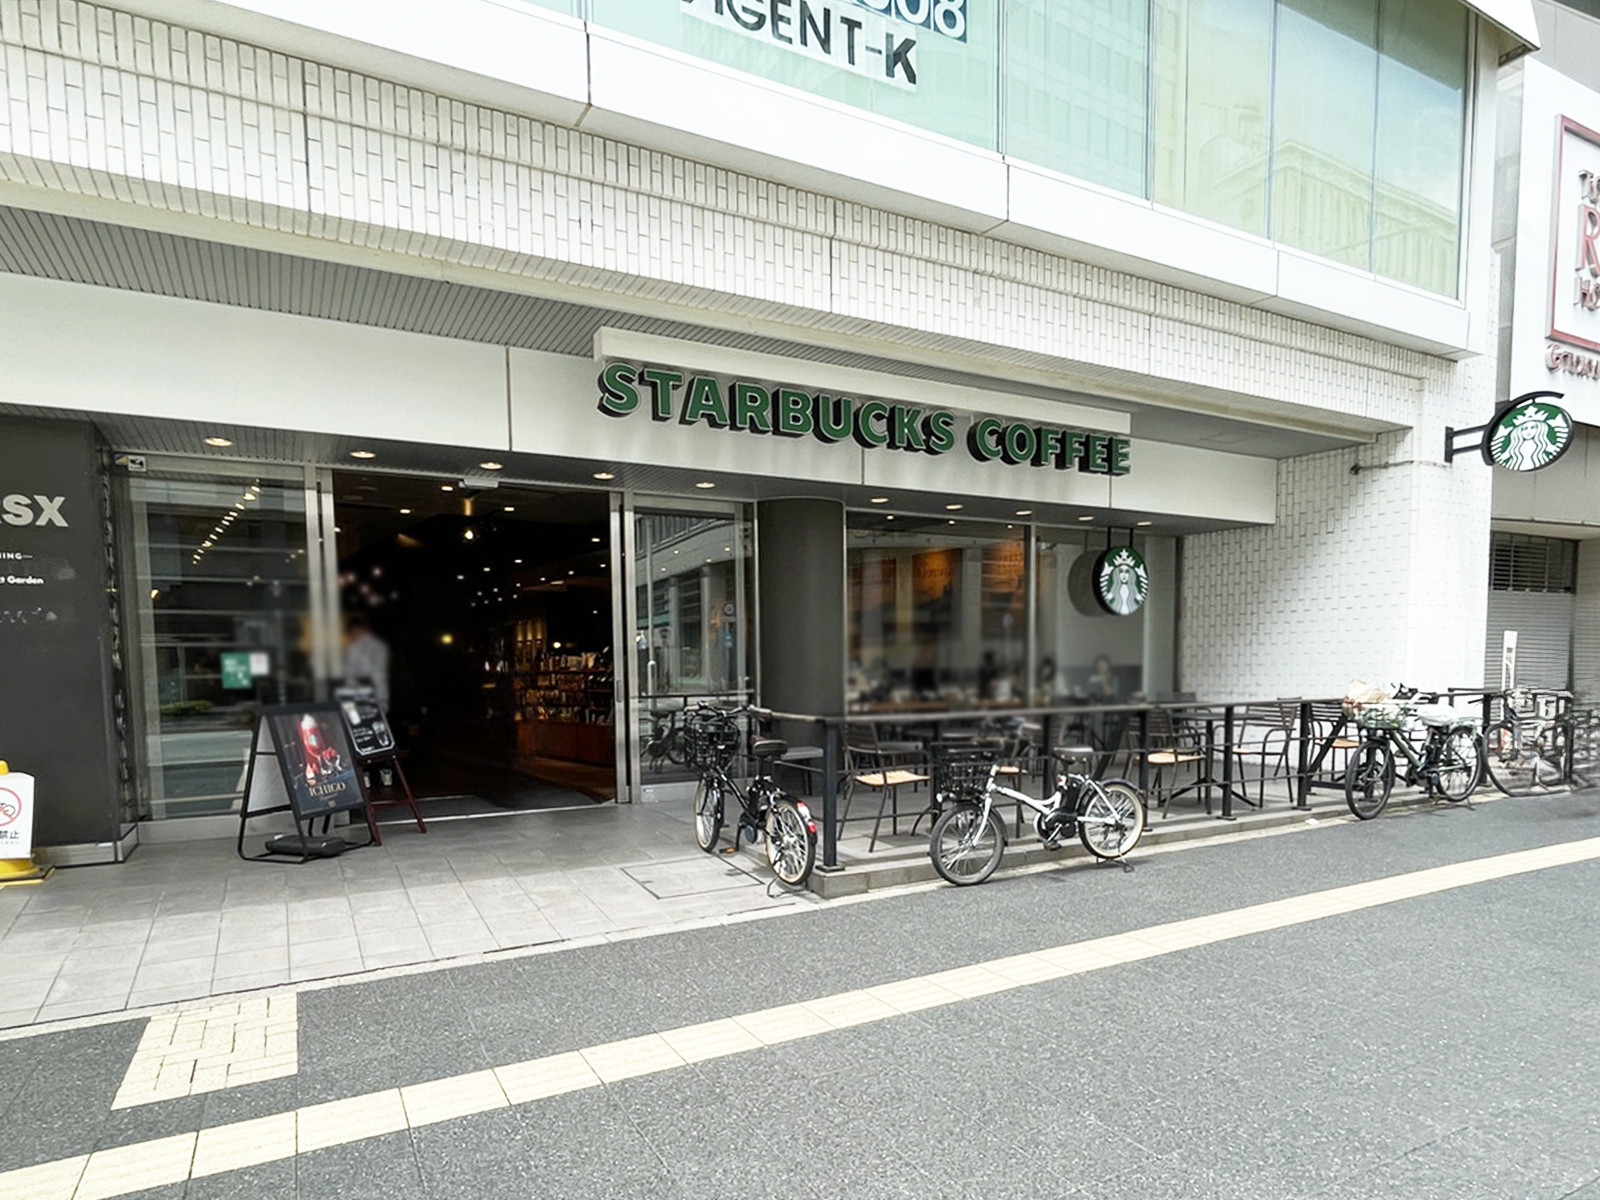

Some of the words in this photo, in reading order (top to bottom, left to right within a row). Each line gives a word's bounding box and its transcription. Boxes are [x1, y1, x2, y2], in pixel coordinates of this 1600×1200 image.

[682, 0, 917, 84] GENT-K
[598, 363, 955, 455] STARBUCKS
[967, 418, 1131, 476] COFFEE
[0, 494, 69, 527] SX
[7, 575, 45, 584] Garden
[308, 782, 346, 797] ICHIGO
